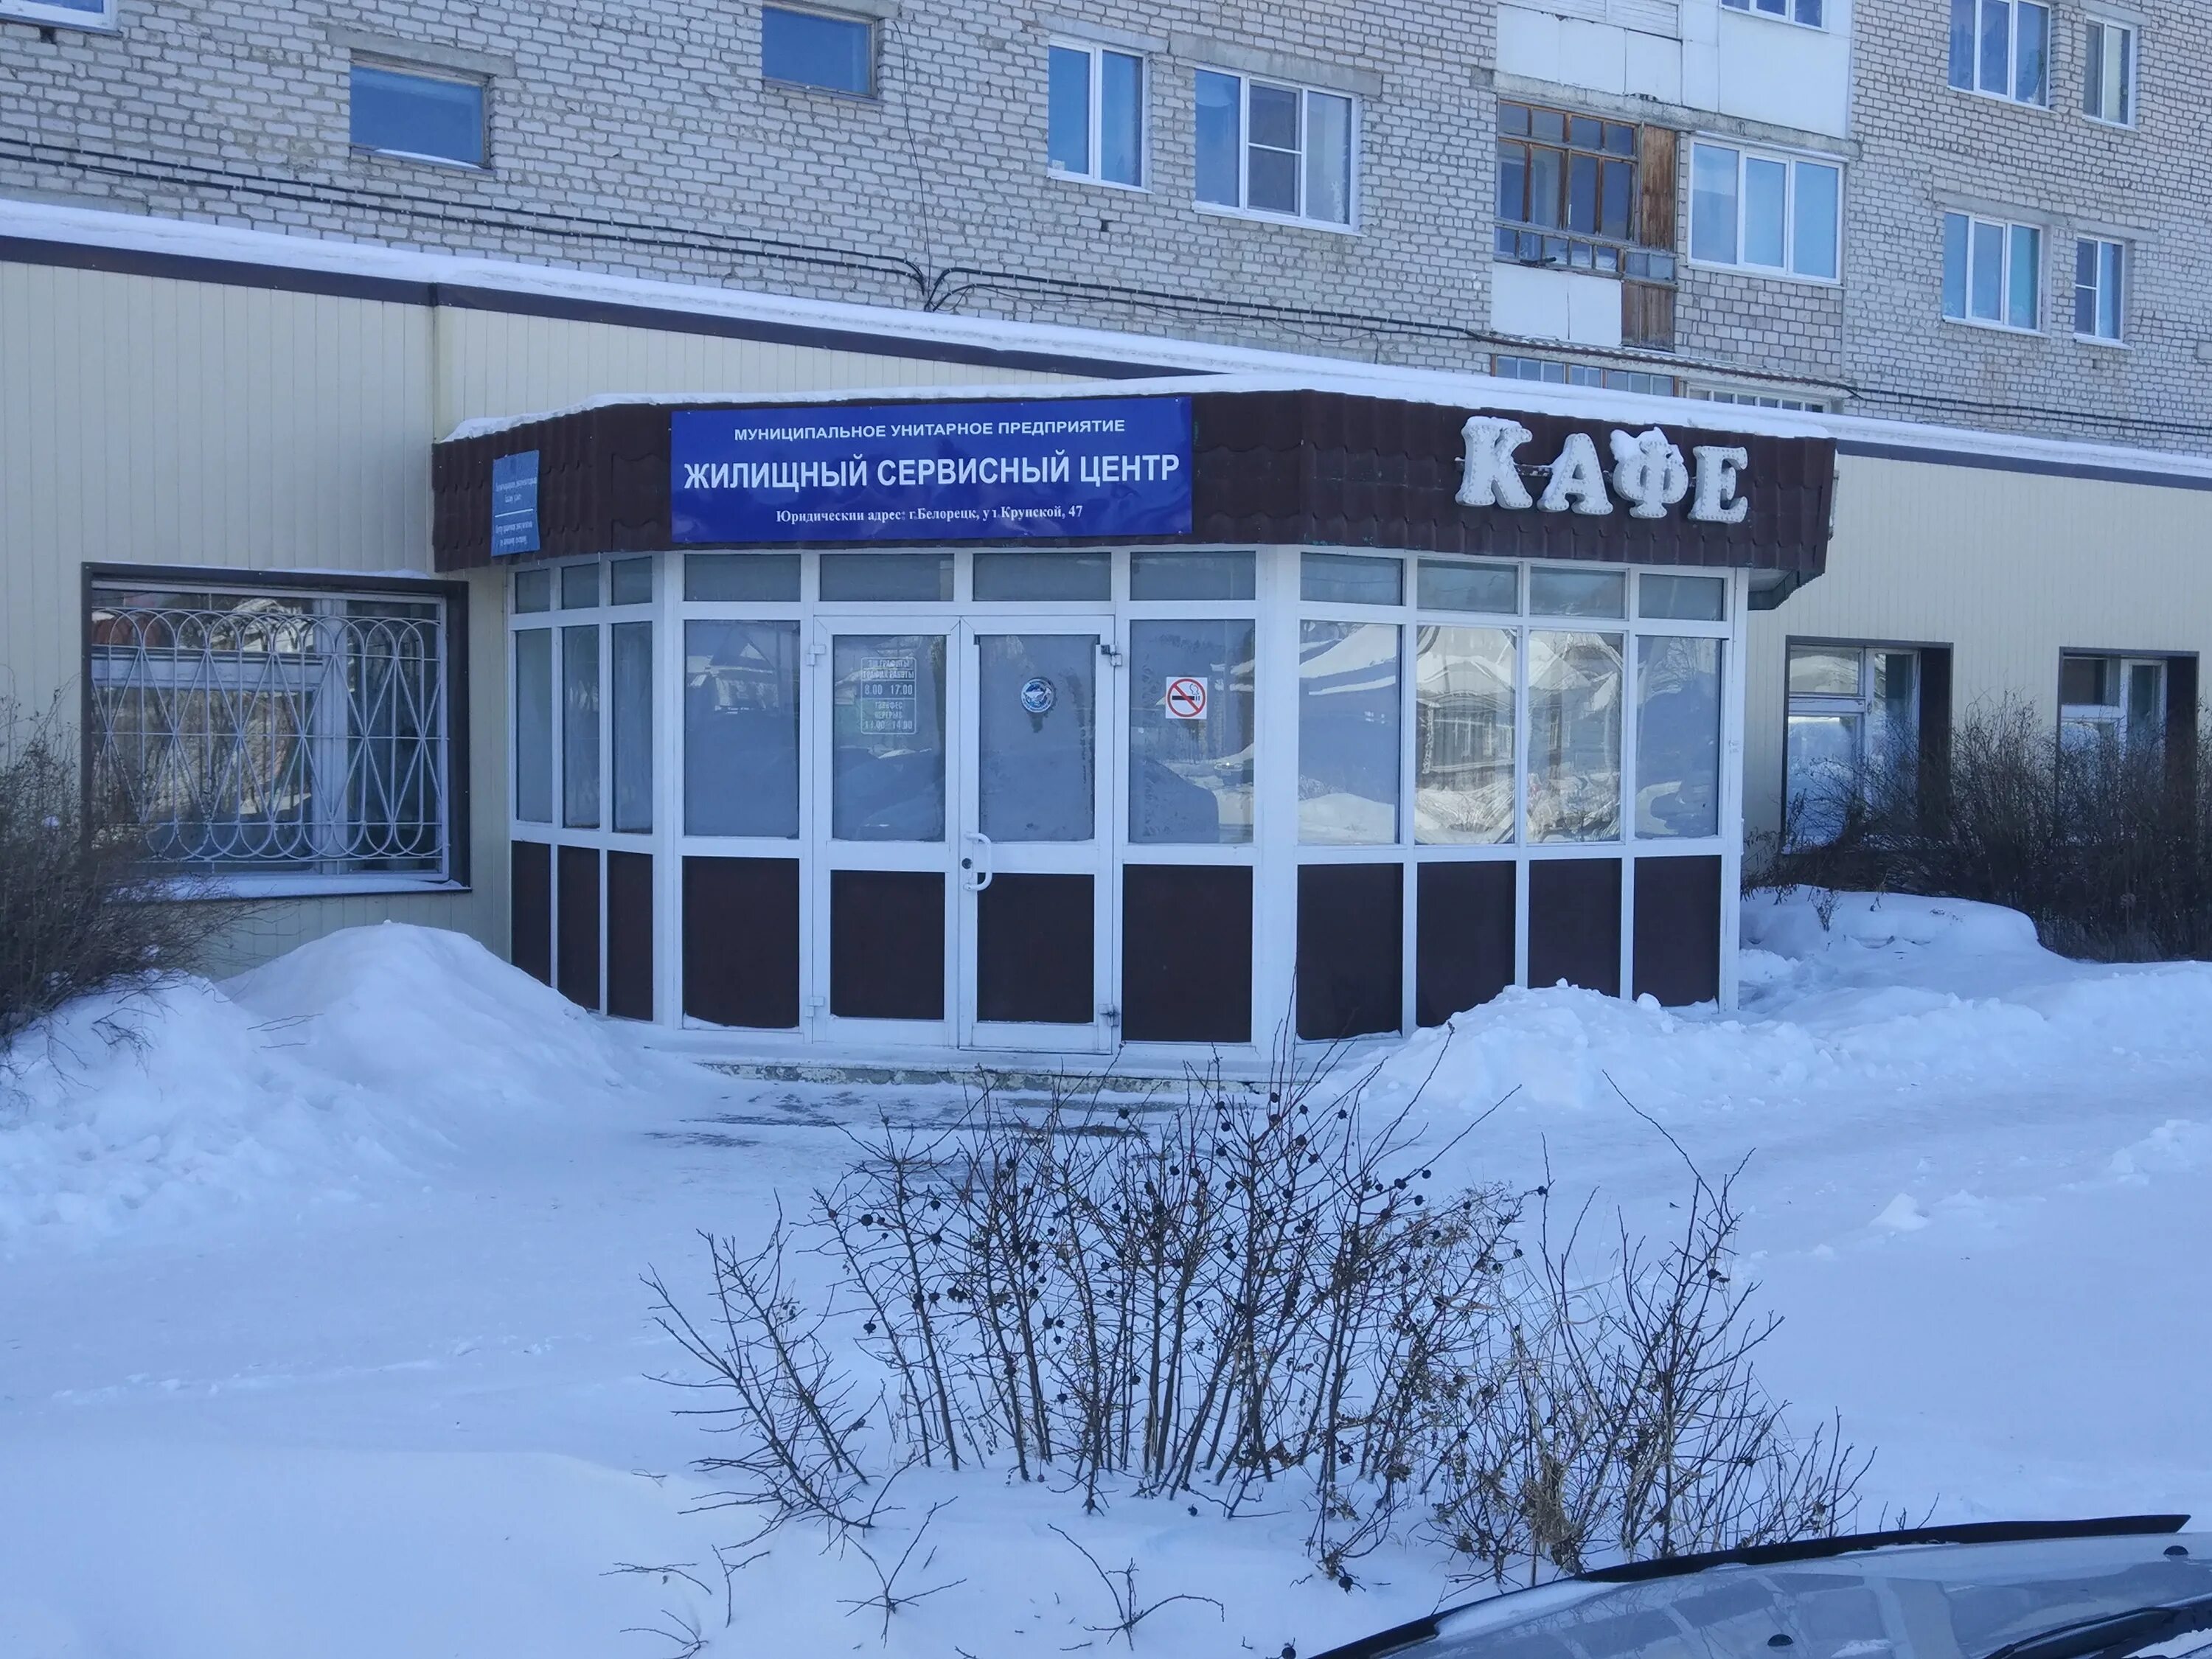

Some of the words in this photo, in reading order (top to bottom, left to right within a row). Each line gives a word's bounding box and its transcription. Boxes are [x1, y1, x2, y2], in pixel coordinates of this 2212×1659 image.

[734, 425, 886, 442] МУНИЦИПАЛЬНОЕ
[890, 422, 993, 437] УНИТАРНОЕ
[998, 419, 1126, 436] ПРЕДПРИЯТИЕ
[684, 453, 868, 493] ЖИЛИЩНЫЙ
[877, 448, 1069, 486] СЕРВИСНЫЙ
[1079, 454, 1180, 487] ЦЕНТР
[1455, 418, 1748, 523] КАФЕ
[1068, 505, 1083, 518] 47
